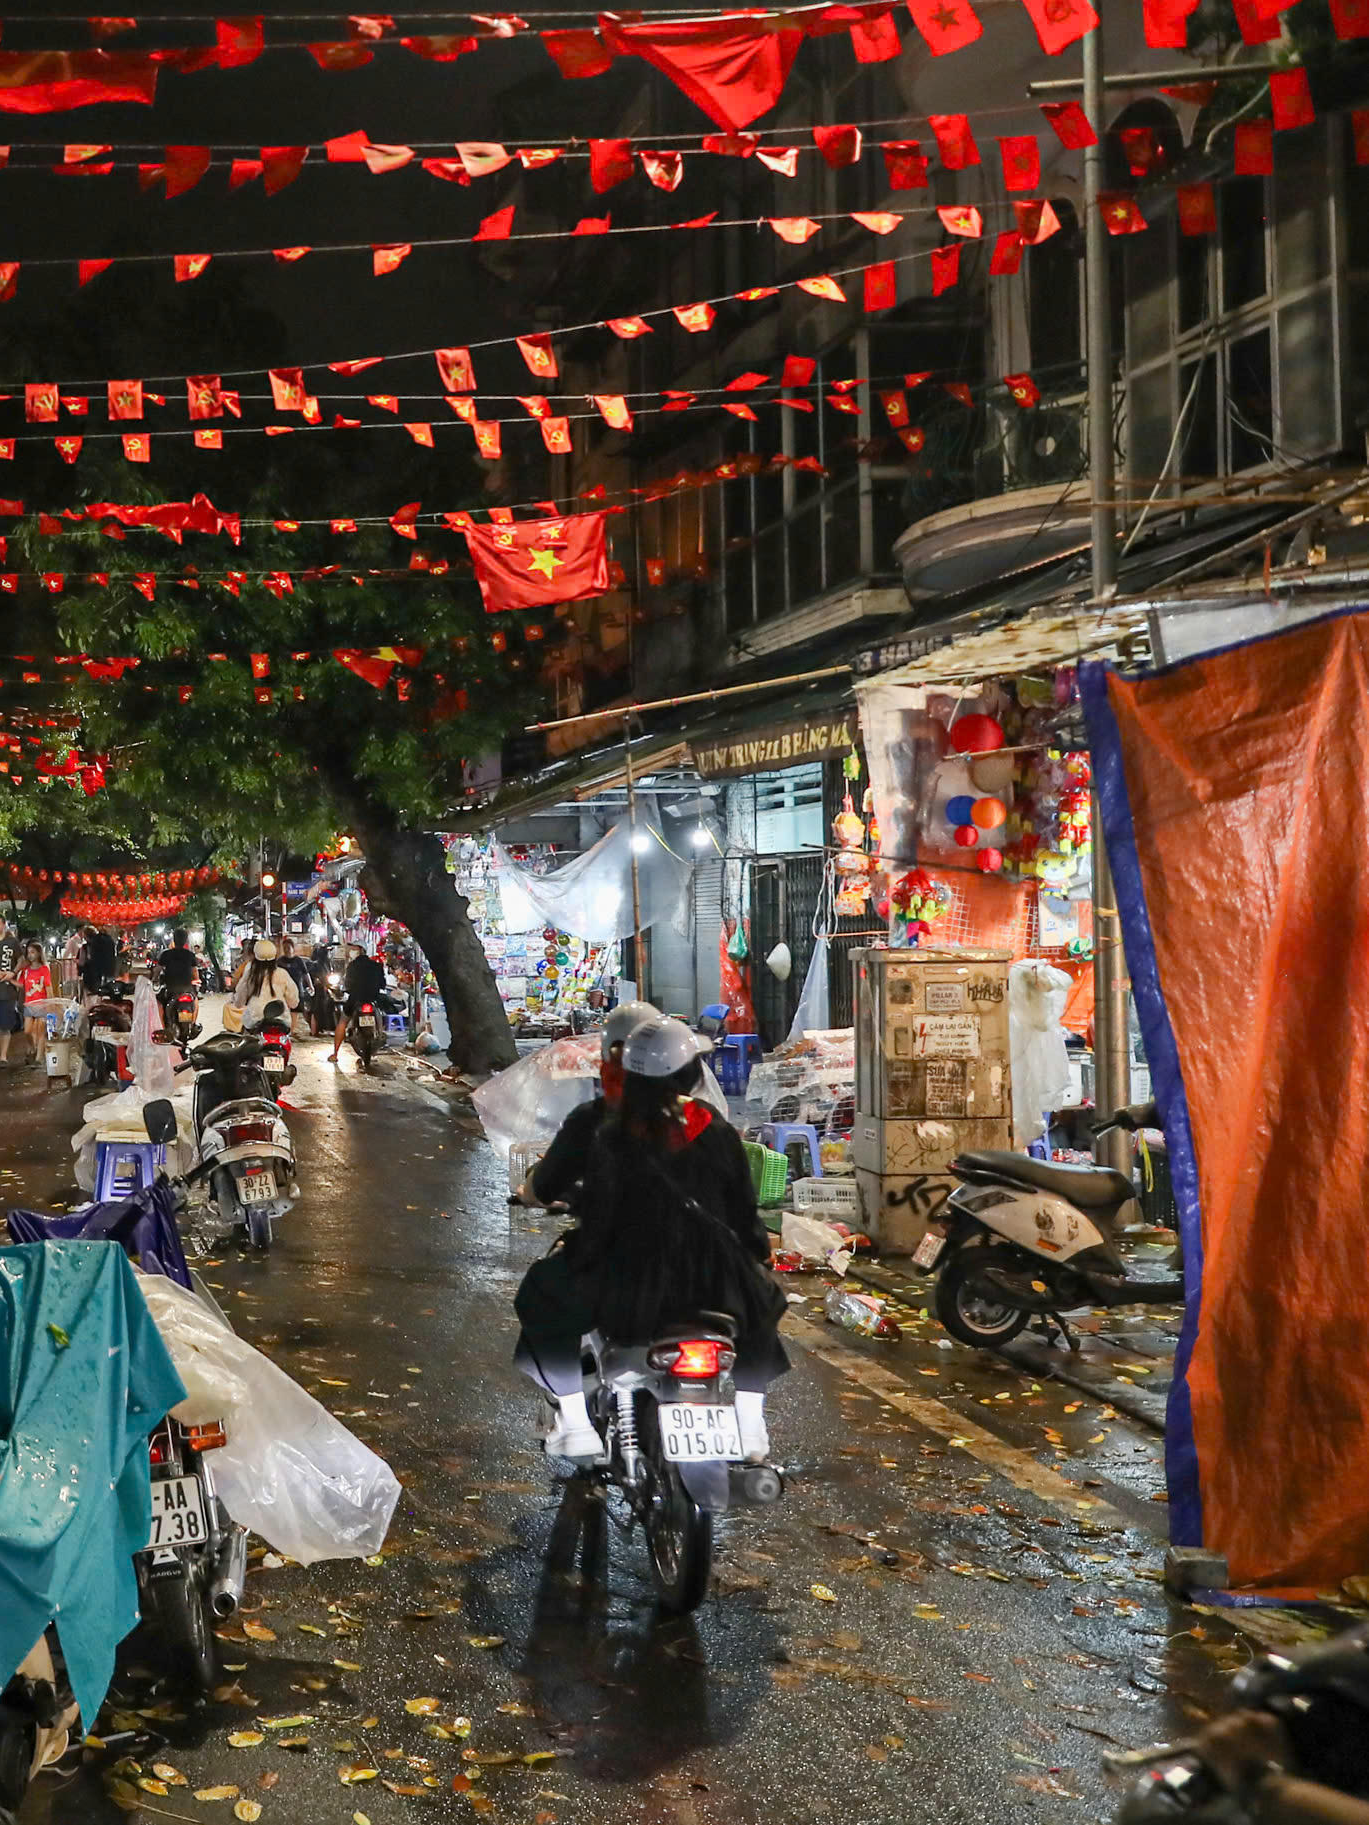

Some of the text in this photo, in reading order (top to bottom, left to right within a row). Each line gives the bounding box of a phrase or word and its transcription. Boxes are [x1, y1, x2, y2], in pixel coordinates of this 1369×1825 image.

[245, 1187, 272, 1200] 6793
[672, 1408, 726, 1430] 90-AC
[667, 1433, 739, 1456] 015.02
[151, 1511, 200, 1544] 7.38
